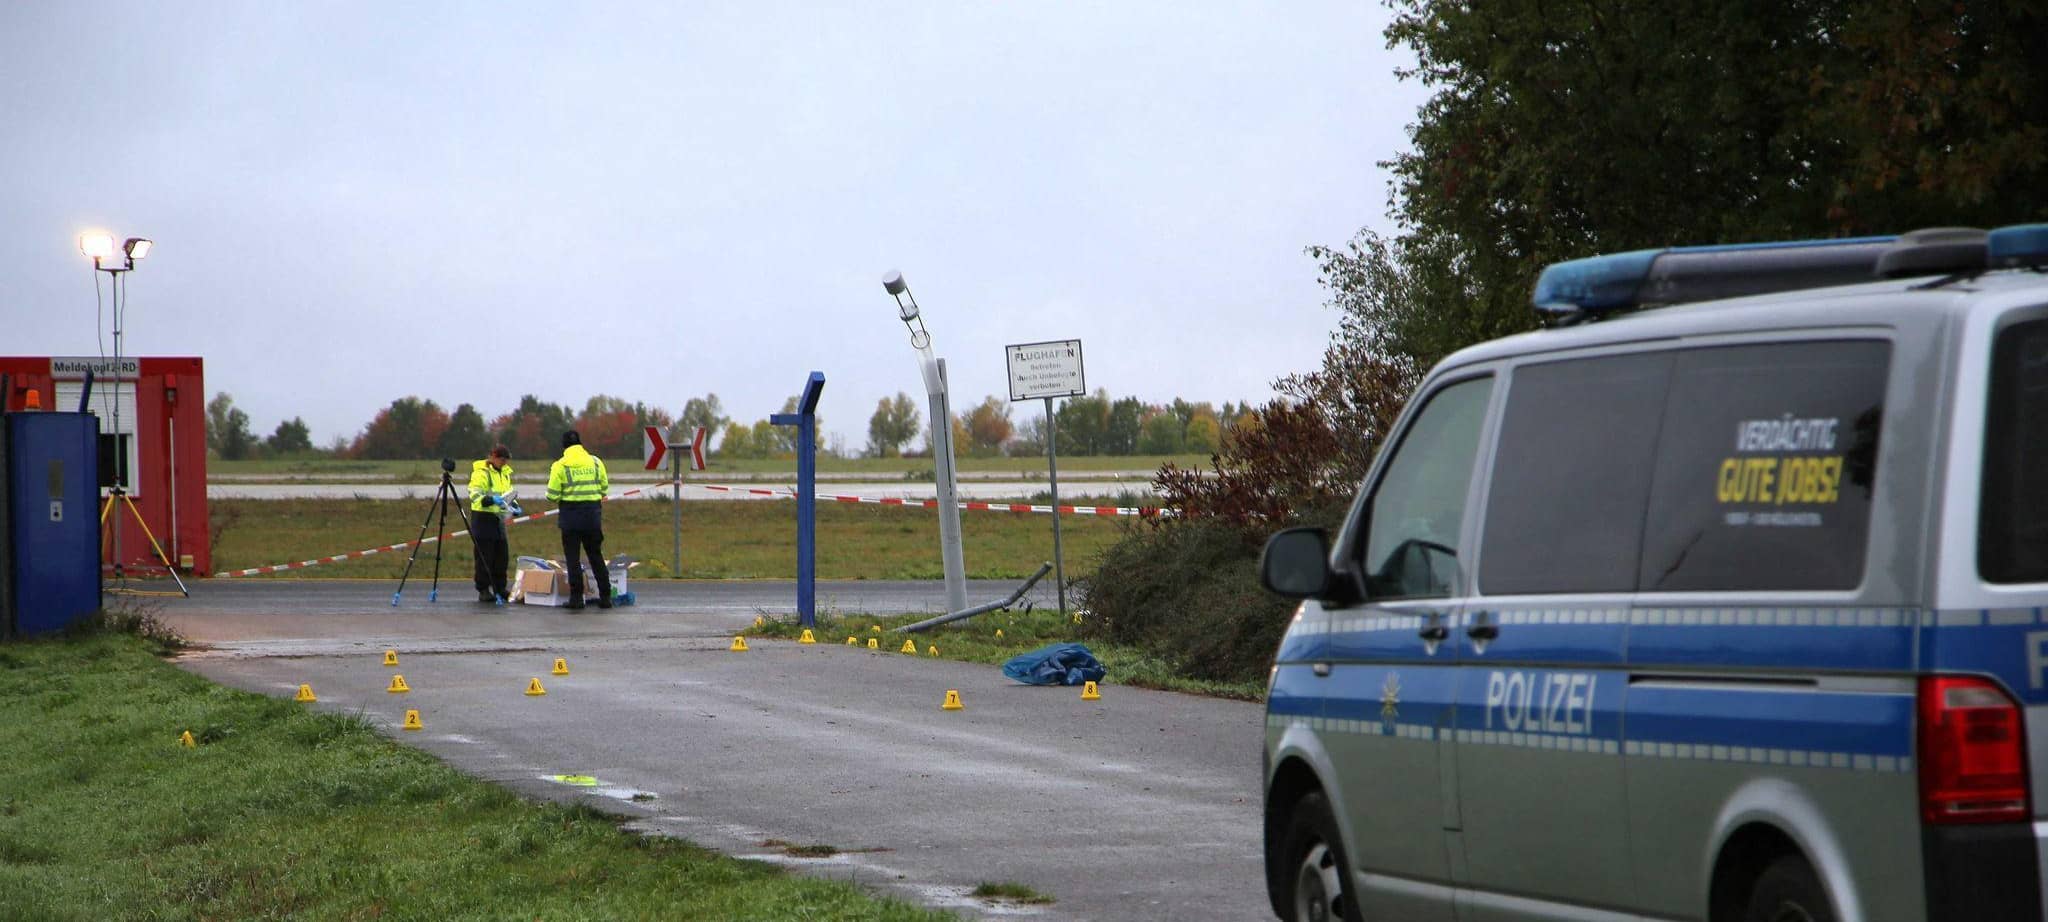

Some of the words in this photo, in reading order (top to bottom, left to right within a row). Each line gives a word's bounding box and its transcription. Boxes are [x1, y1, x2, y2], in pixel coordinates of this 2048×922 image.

[1738, 413, 1838, 451] VERDÄCHTIG
[1718, 457, 1778, 503] GUTE
[1775, 456, 1844, 506] JOBS!
[409, 713, 416, 724] 2
[1485, 671, 1598, 735] POLIZEI
